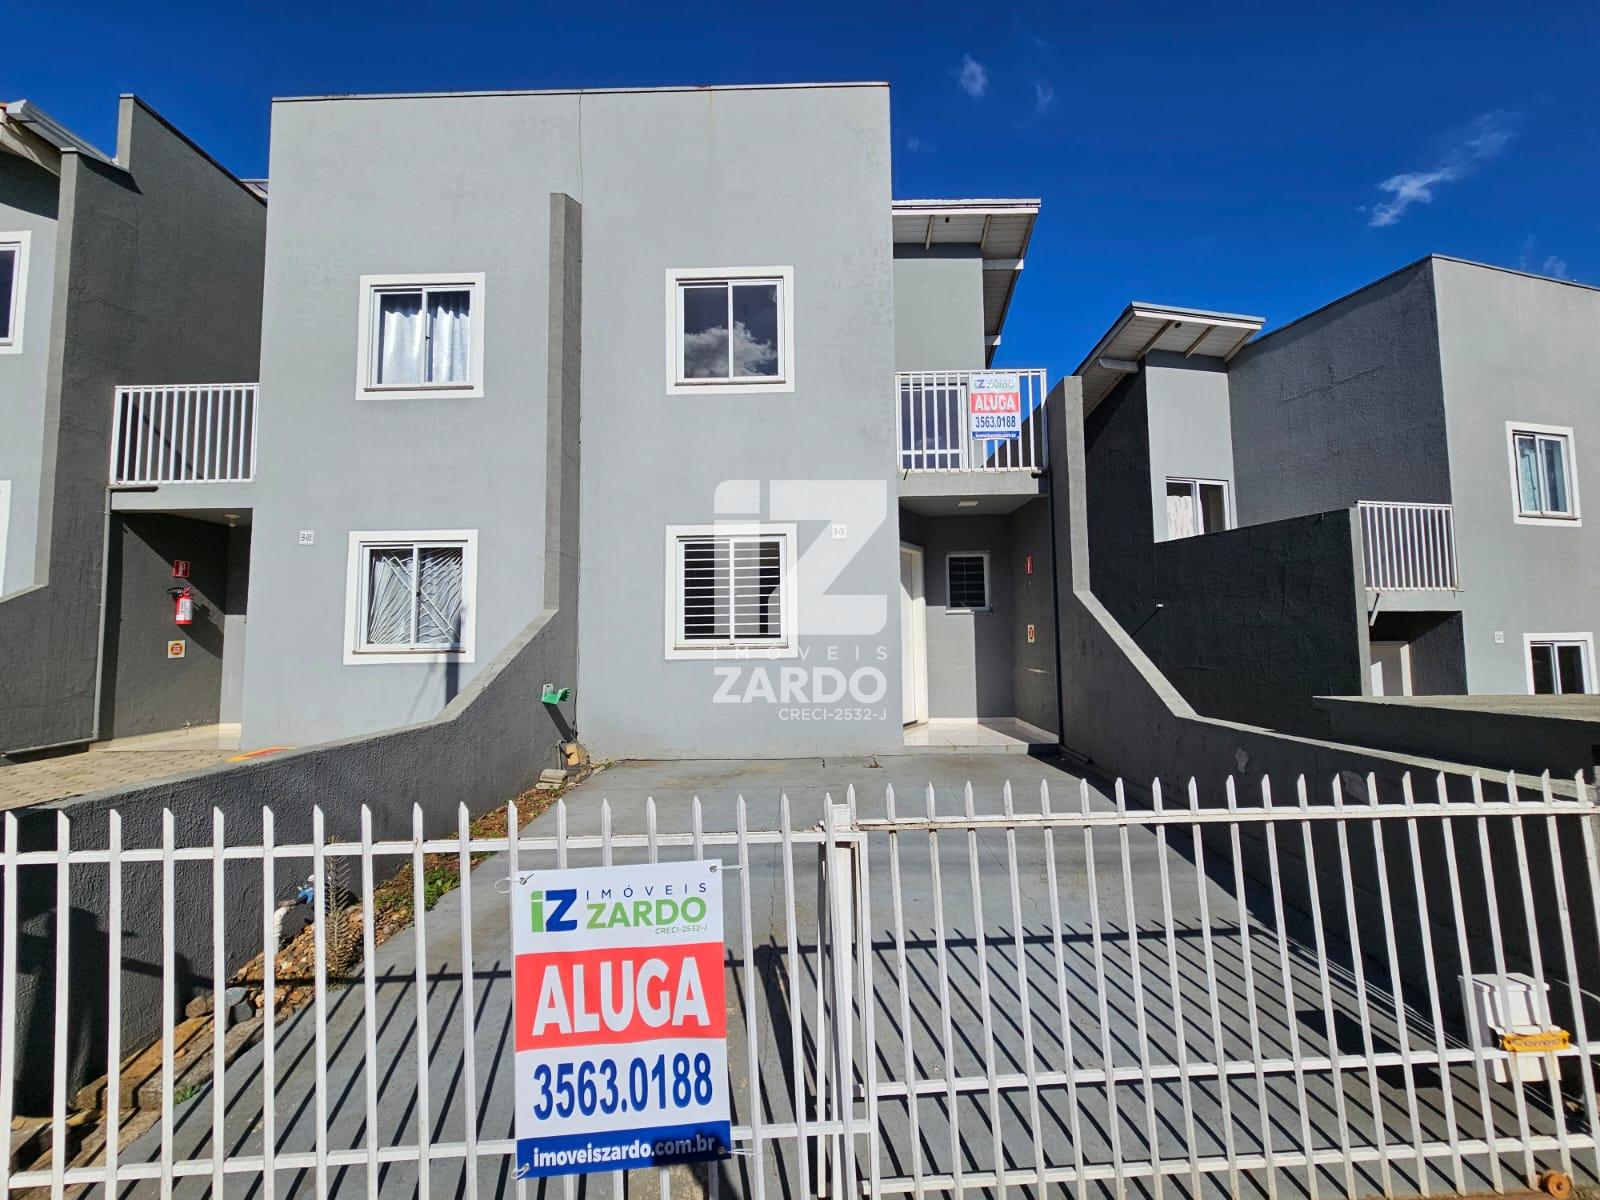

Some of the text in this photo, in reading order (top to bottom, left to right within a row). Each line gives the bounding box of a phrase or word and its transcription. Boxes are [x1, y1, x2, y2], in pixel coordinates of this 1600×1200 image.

[974, 394, 1016, 412] ALUGA
[975, 415, 1016, 429] 3563.0188
[585, 882, 707, 900] IMÓVEIS
[585, 896, 707, 930] ZARDO
[655, 924, 708, 935] CRECI-2532-J
[531, 956, 710, 1037] ALUGA
[533, 1052, 713, 1121] 3563.0188
[533, 1133, 715, 1169] imoveiszardo.com.br
